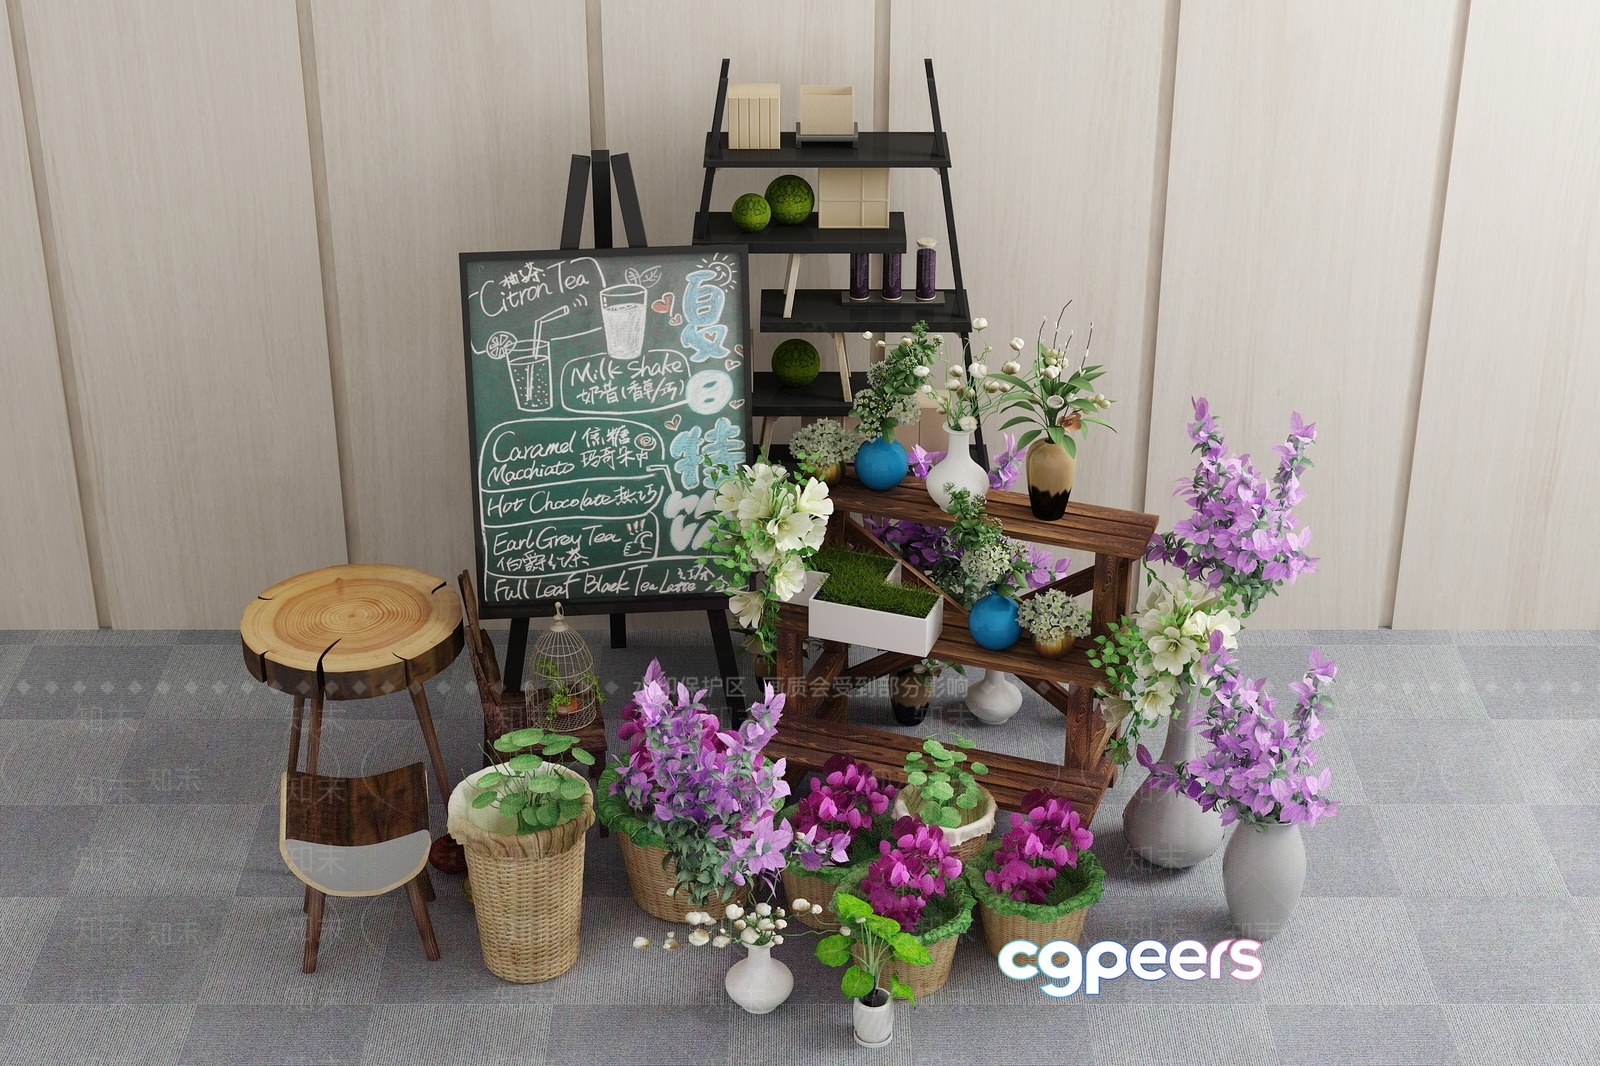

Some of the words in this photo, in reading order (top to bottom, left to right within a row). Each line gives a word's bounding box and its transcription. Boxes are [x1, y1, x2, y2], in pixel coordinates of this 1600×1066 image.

[480, 280, 553, 317] Citron
[546, 260, 590, 293] Tea
[571, 356, 623, 387] Milk
[492, 430, 577, 463] Caramel
[487, 494, 527, 518] Hot
[529, 488, 615, 514] Chocolate
[493, 528, 535, 556] Earl
[535, 526, 582, 550] Grey
[582, 524, 622, 547] Tea
[494, 578, 530, 602] Full
[535, 573, 581, 600] Leaf
[584, 570, 630, 595] Black
[628, 564, 658, 597] Tea
